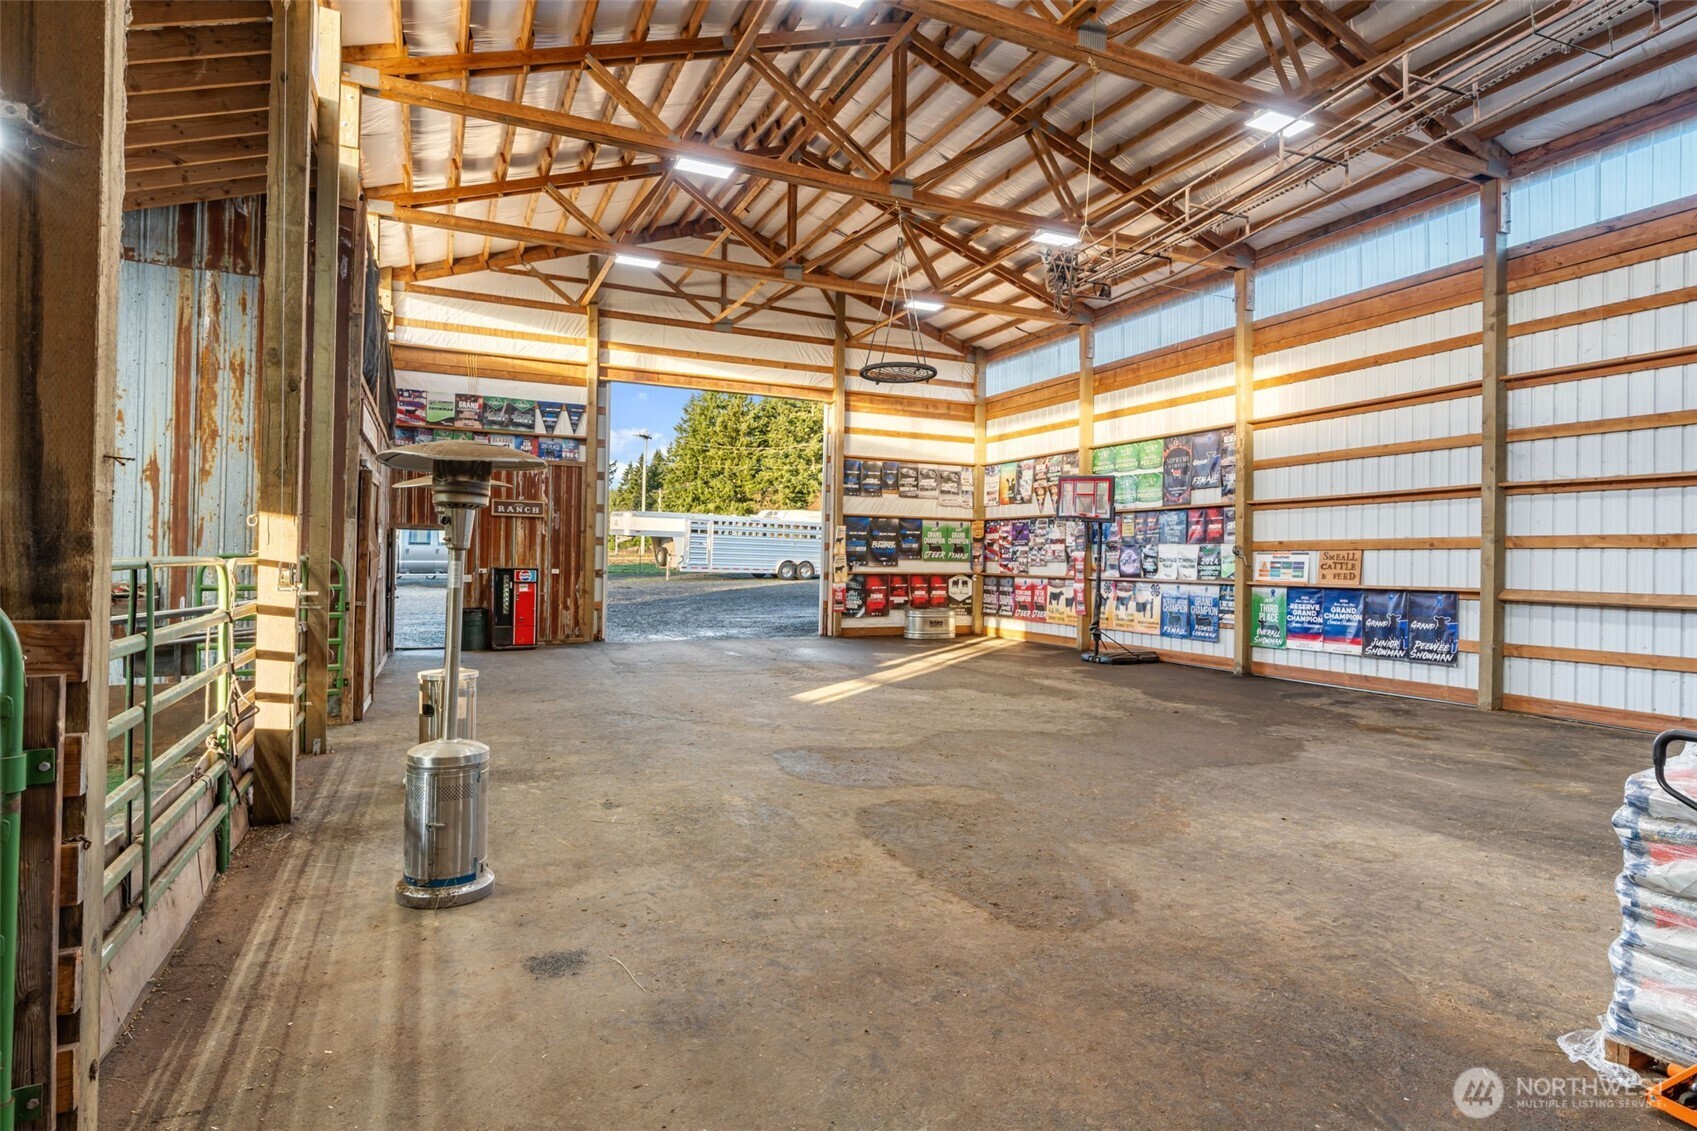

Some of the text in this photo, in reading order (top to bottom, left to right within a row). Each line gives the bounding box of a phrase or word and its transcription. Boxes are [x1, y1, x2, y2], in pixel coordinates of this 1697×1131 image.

[1166, 456, 1190, 464] SUPREME
[498, 505, 540, 514] RANCH
[923, 551, 946, 559] STEER
[1320, 561, 1357, 571] CATTLE
[1333, 572, 1357, 581] FEED
[1194, 597, 1213, 607] GRAND
[1289, 603, 1320, 611] RESERVE
[1190, 605, 1219, 616] CHAMPION
[1259, 603, 1279, 613] THIRD
[1330, 606, 1357, 614] GRAND
[1259, 612, 1279, 623] PLACE
[1286, 614, 1323, 624] CHAMPION
[1323, 612, 1363, 621] CHAMPION
[1365, 618, 1388, 628] GRAND
[1410, 620, 1436, 630] GRAND
[1256, 627, 1281, 638] OVERALL
[1254, 635, 1284, 645] SHOWMAN
[1371, 637, 1400, 649] JUNIOR
[1413, 640, 1451, 652] PEEWEE
[1365, 646, 1406, 658] SHOWMAN
[1409, 649, 1454, 662] SHOWMAN
